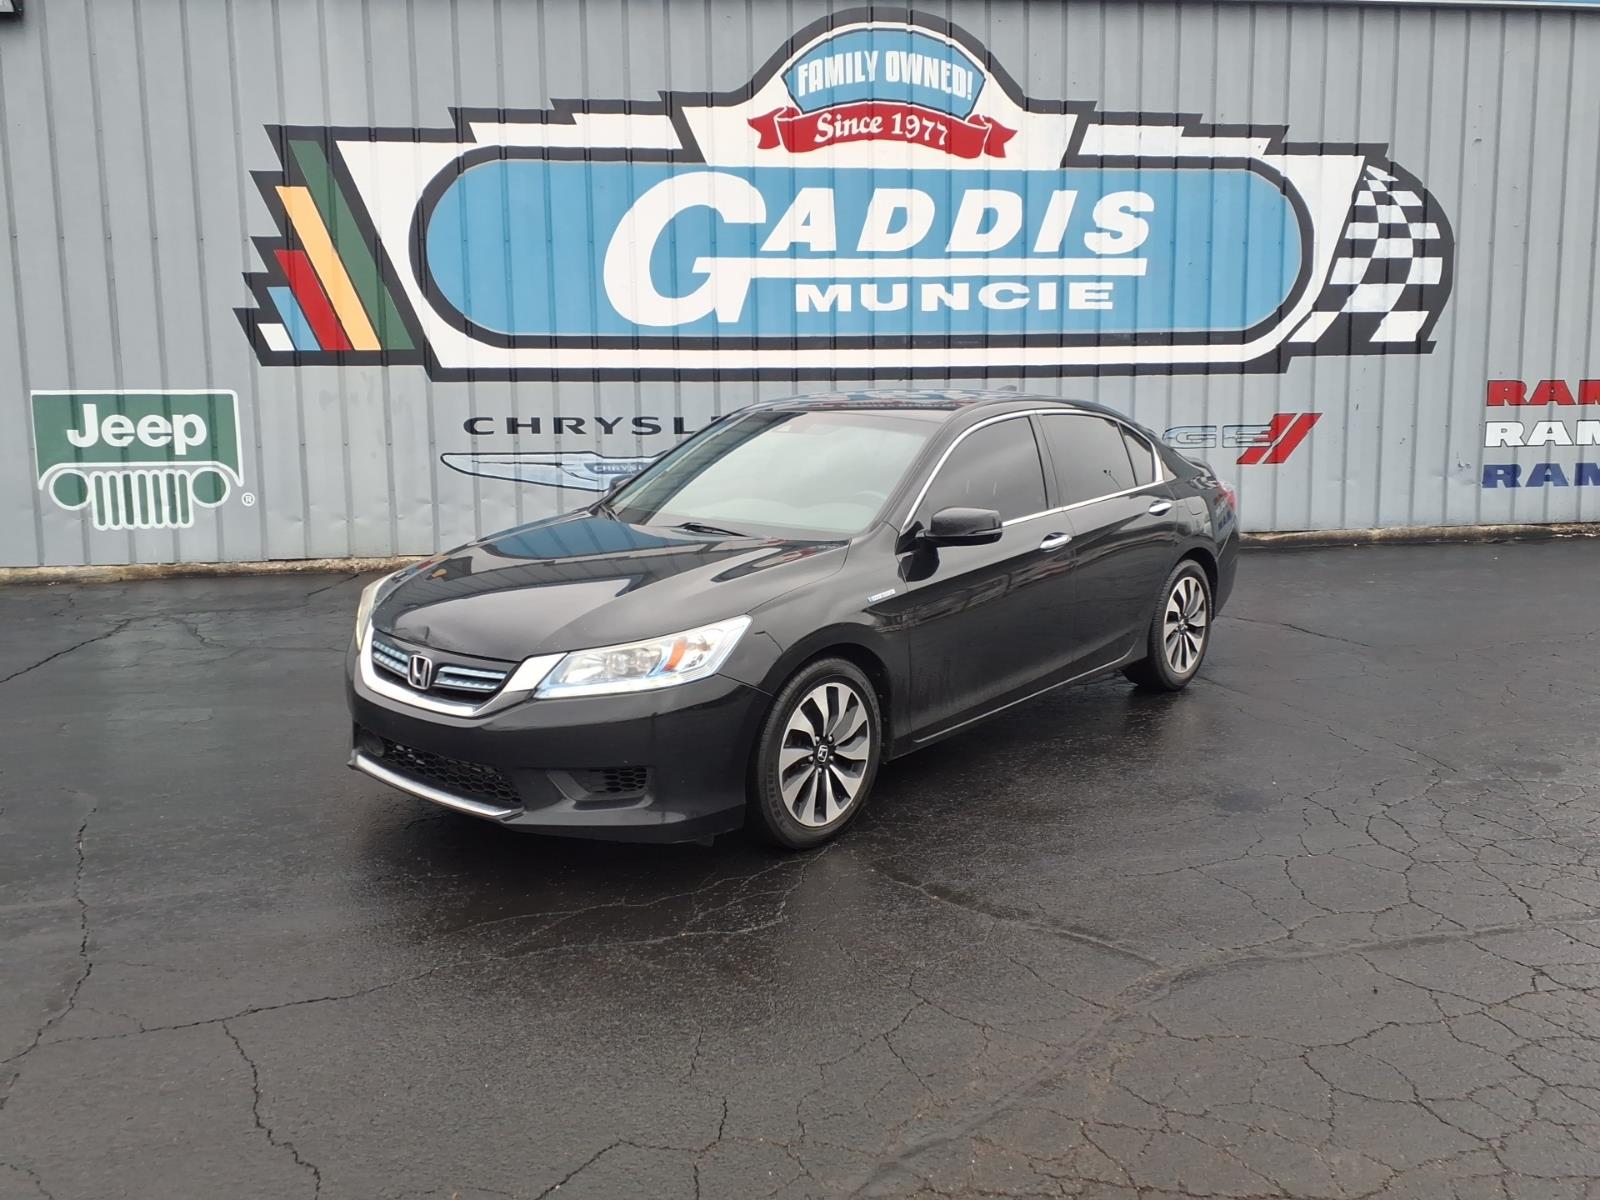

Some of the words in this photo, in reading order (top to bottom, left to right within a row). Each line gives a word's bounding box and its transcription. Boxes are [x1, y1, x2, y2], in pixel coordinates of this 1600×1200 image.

[797, 50, 877, 97] FAMILY
[885, 51, 973, 100] OWNED!
[813, 112, 885, 143] Since
[891, 112, 948, 146] 1977
[603, 171, 1155, 327] GADDIS
[794, 282, 1114, 312] MUNCIE
[66, 403, 207, 455] Jeep
[463, 415, 721, 435] CHRYSL
